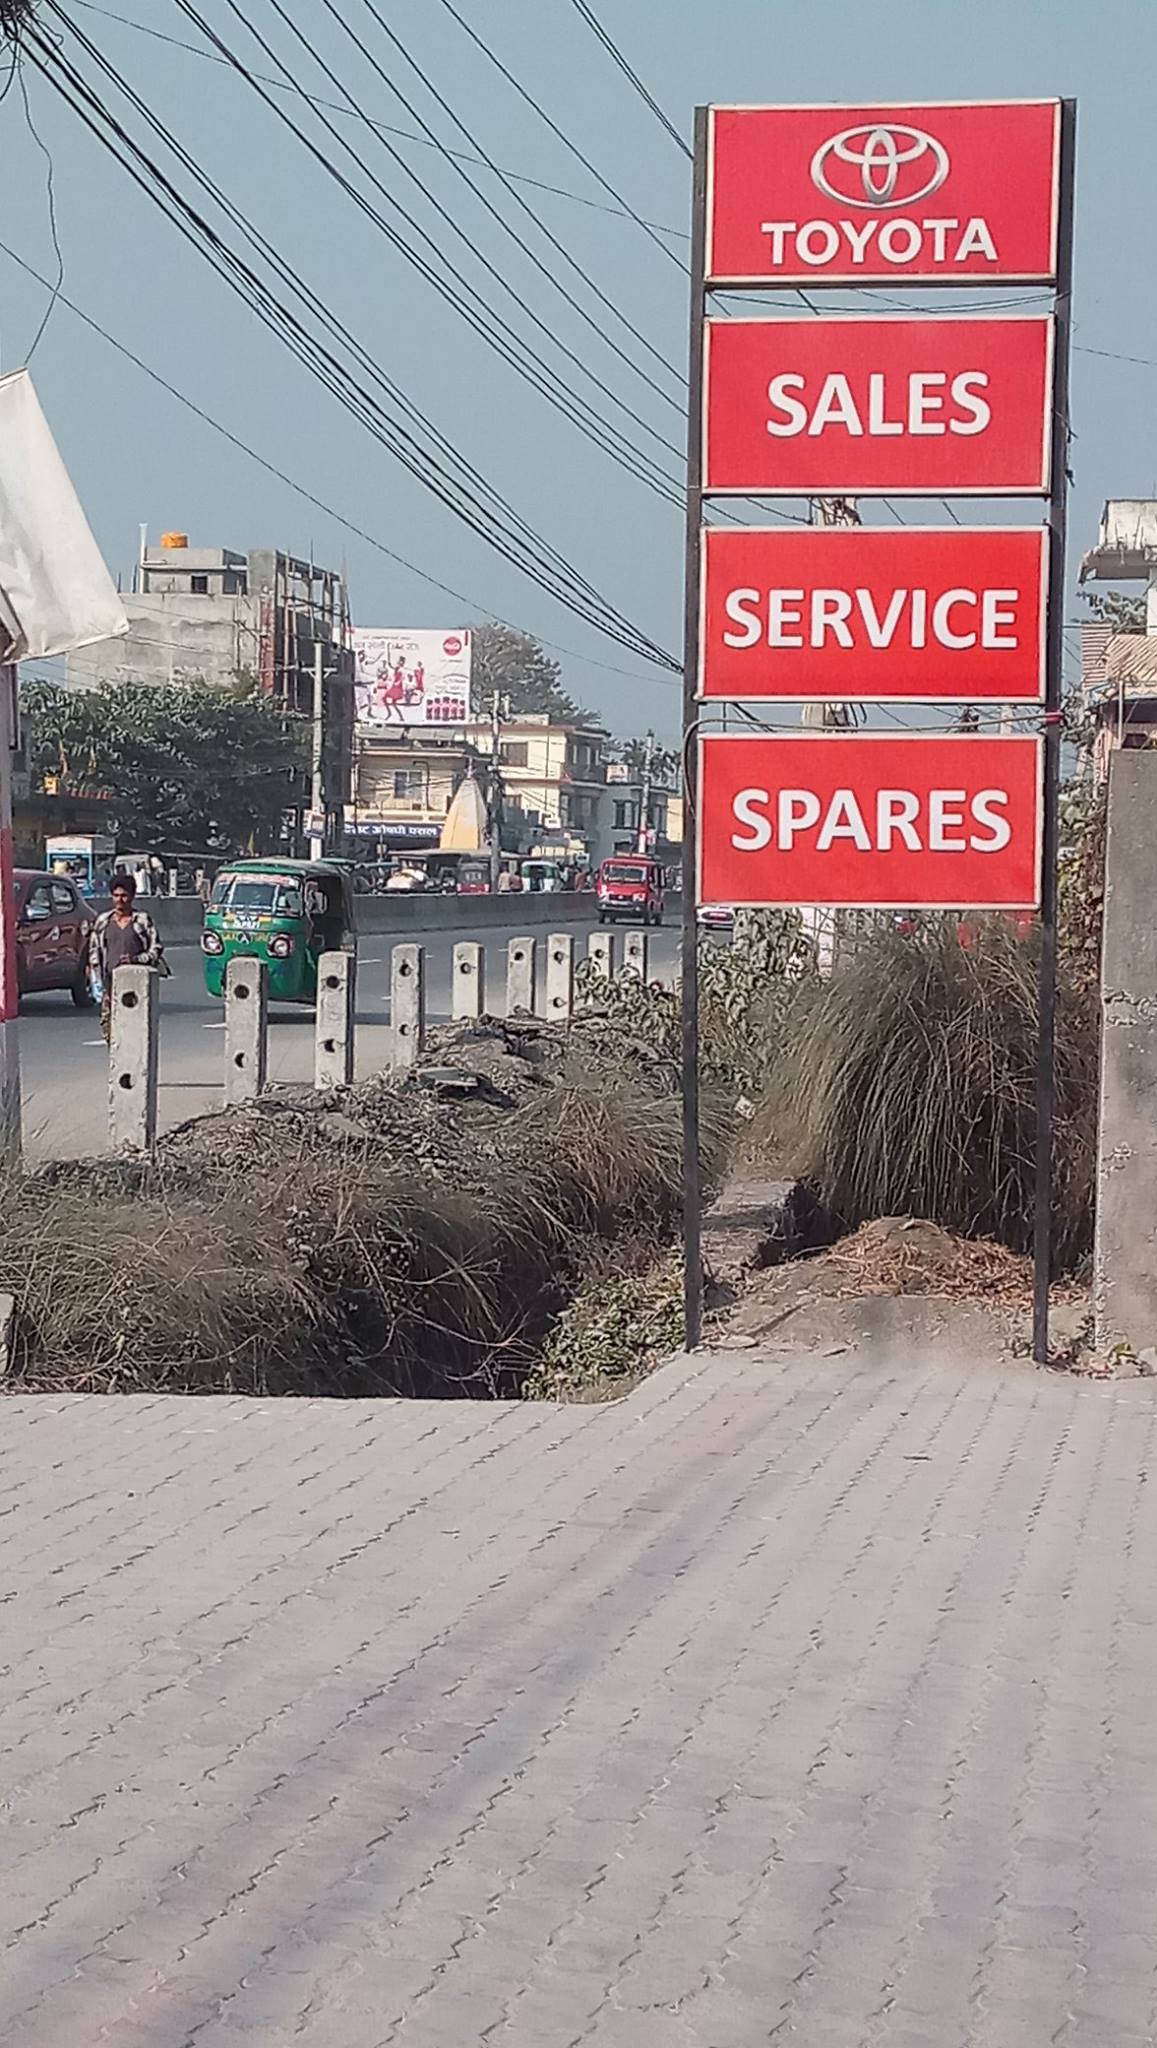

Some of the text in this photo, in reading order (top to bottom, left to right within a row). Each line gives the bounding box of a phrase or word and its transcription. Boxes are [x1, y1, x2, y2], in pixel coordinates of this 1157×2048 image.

[761, 218, 998, 265] TOYOTA
[767, 372, 991, 437] SALES
[723, 588, 1018, 649] SERVICE
[731, 788, 1011, 852] SPARES
